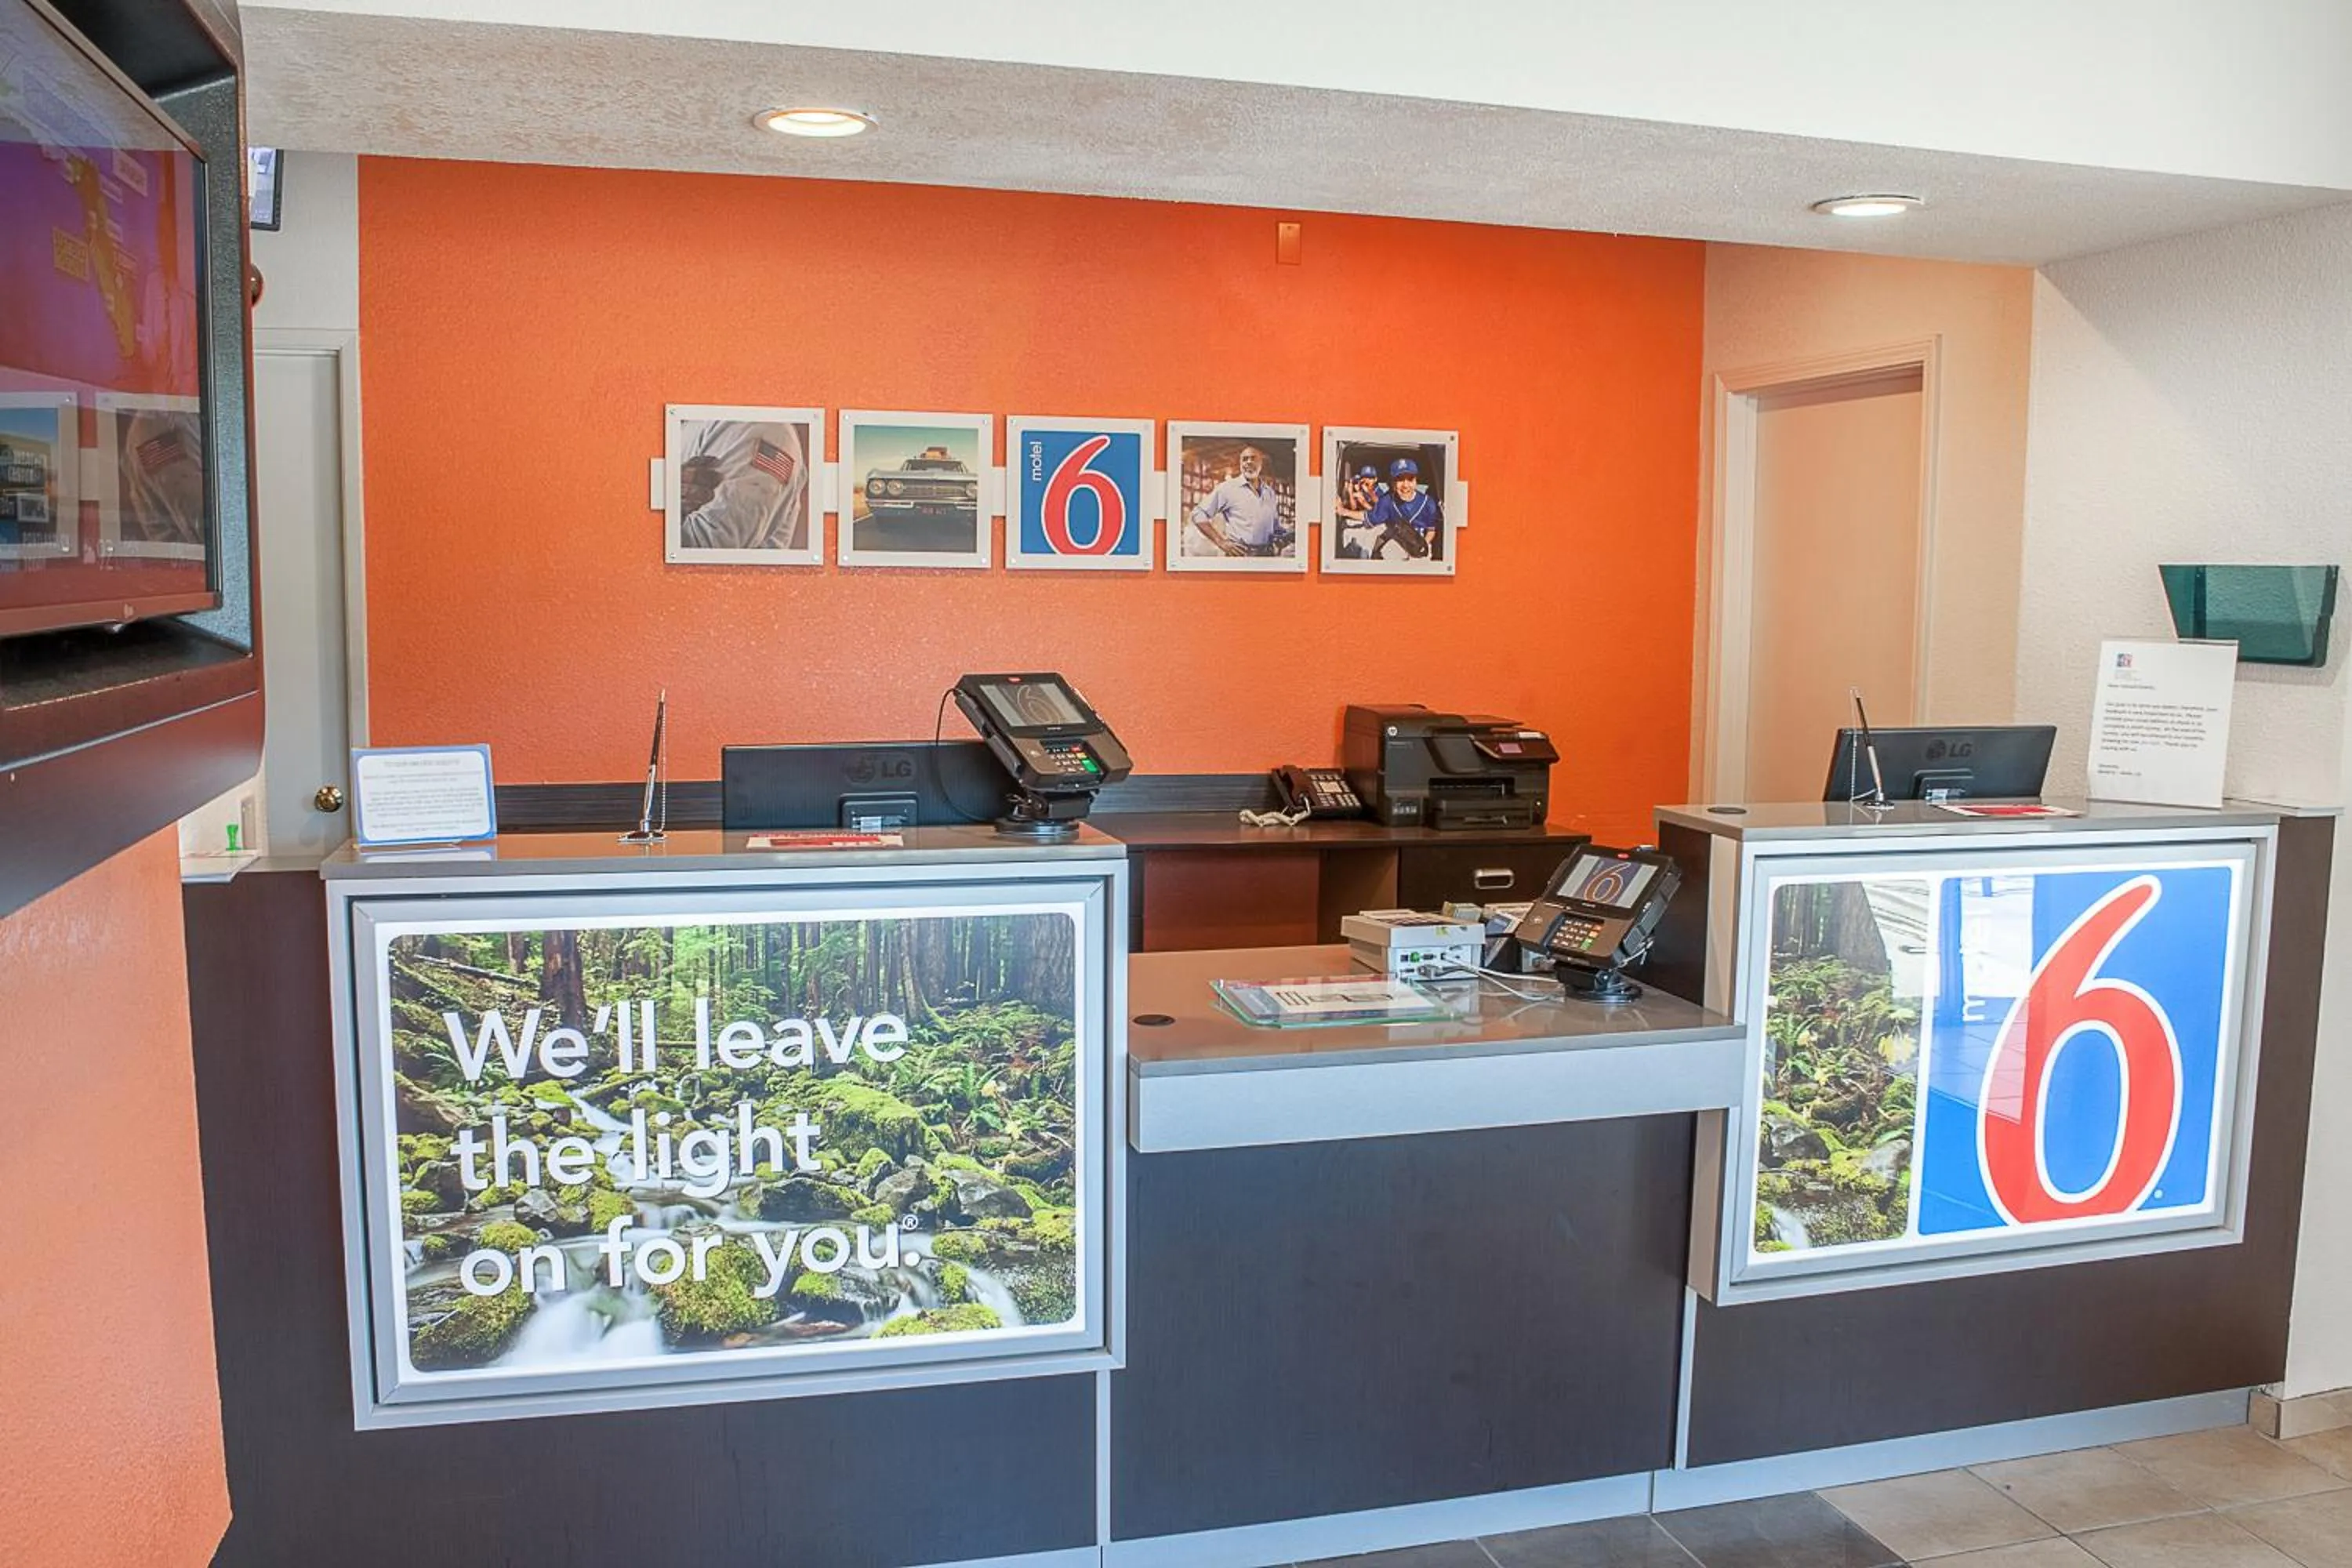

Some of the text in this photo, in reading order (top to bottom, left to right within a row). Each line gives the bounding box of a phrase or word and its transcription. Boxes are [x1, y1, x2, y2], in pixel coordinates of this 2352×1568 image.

[1029, 434, 1126, 556] motel 6
[881, 760, 912, 779] LG
[1948, 742, 1973, 758] LG
[1584, 862, 1632, 902] 6
[442, 996, 909, 1081] We'll leave
[1976, 874, 2183, 1225] 6
[449, 1102, 822, 1198] the light
[460, 1247, 566, 1296] on
[598, 1214, 724, 1288] for
